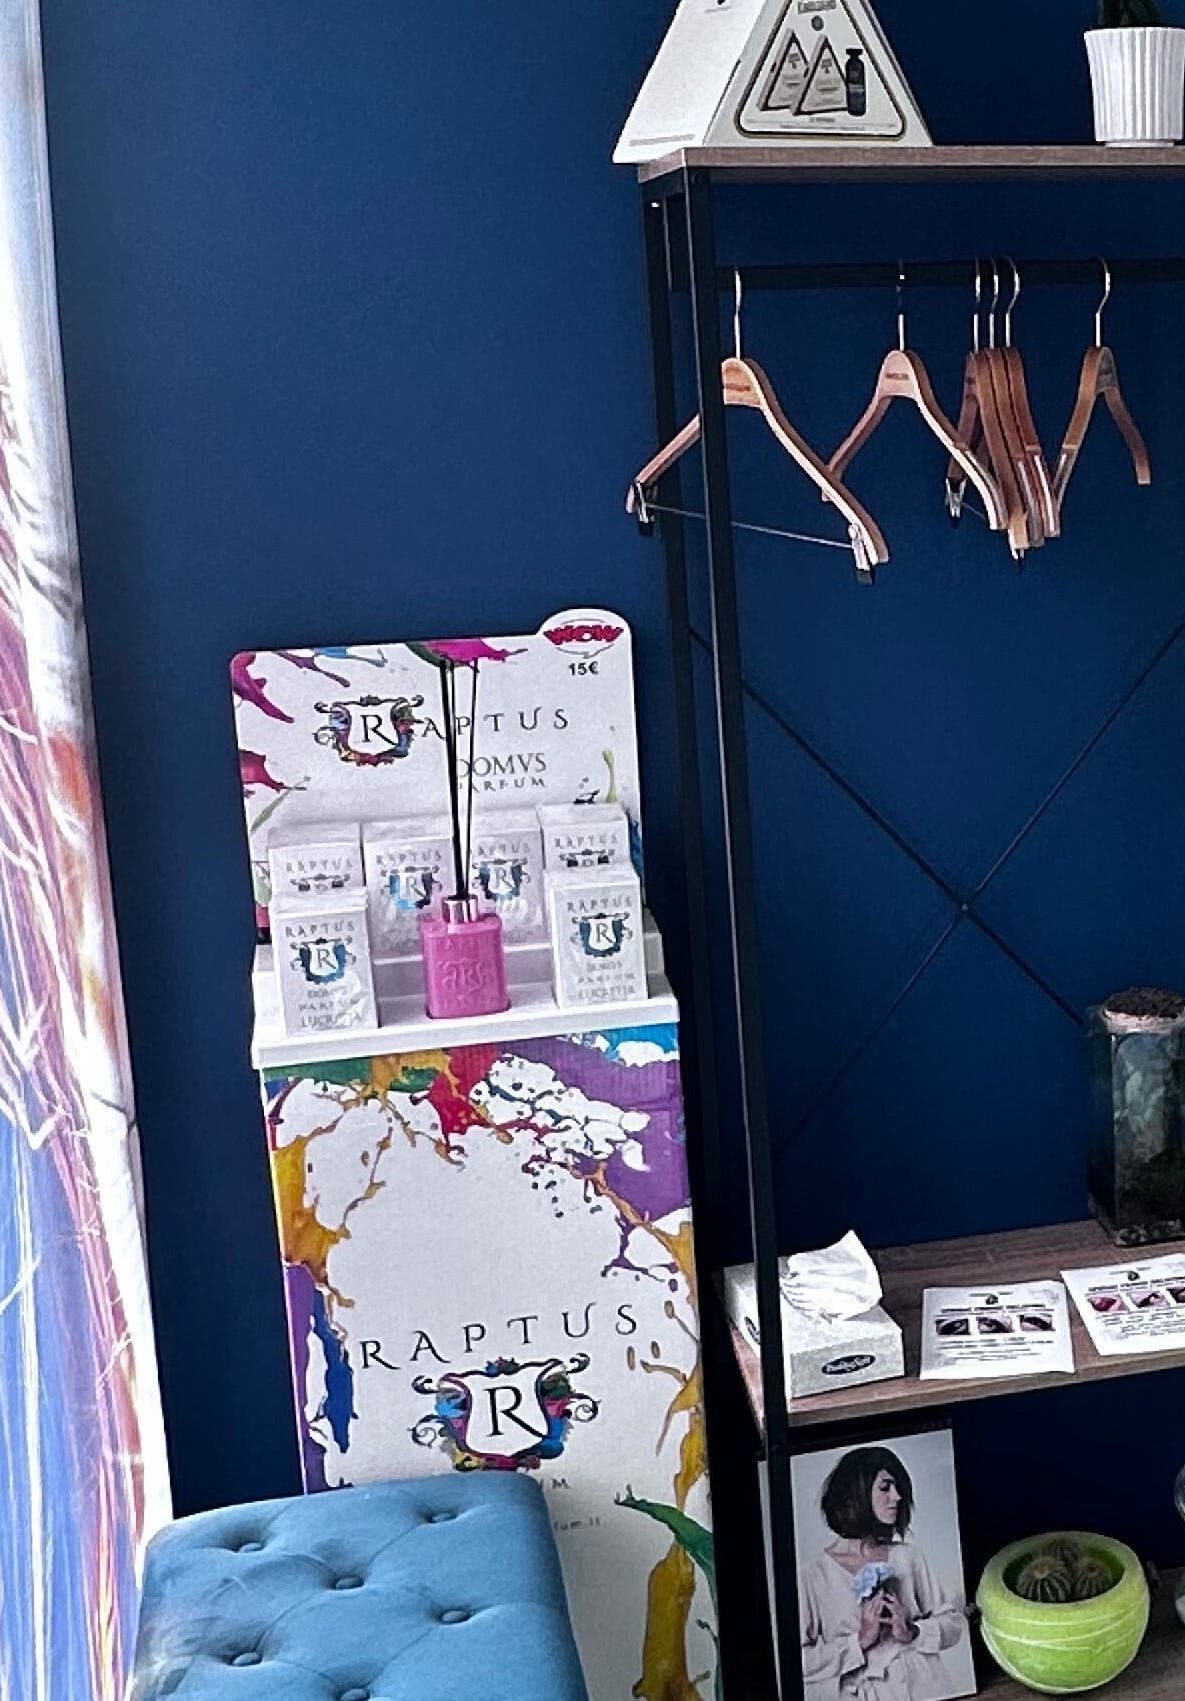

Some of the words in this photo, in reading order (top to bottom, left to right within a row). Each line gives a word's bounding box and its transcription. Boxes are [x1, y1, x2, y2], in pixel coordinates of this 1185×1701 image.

[543, 625, 624, 645] WOW
[568, 661, 599, 676] 15€
[359, 1302, 637, 1370] RAPTUS
[483, 1386, 549, 1437] R
